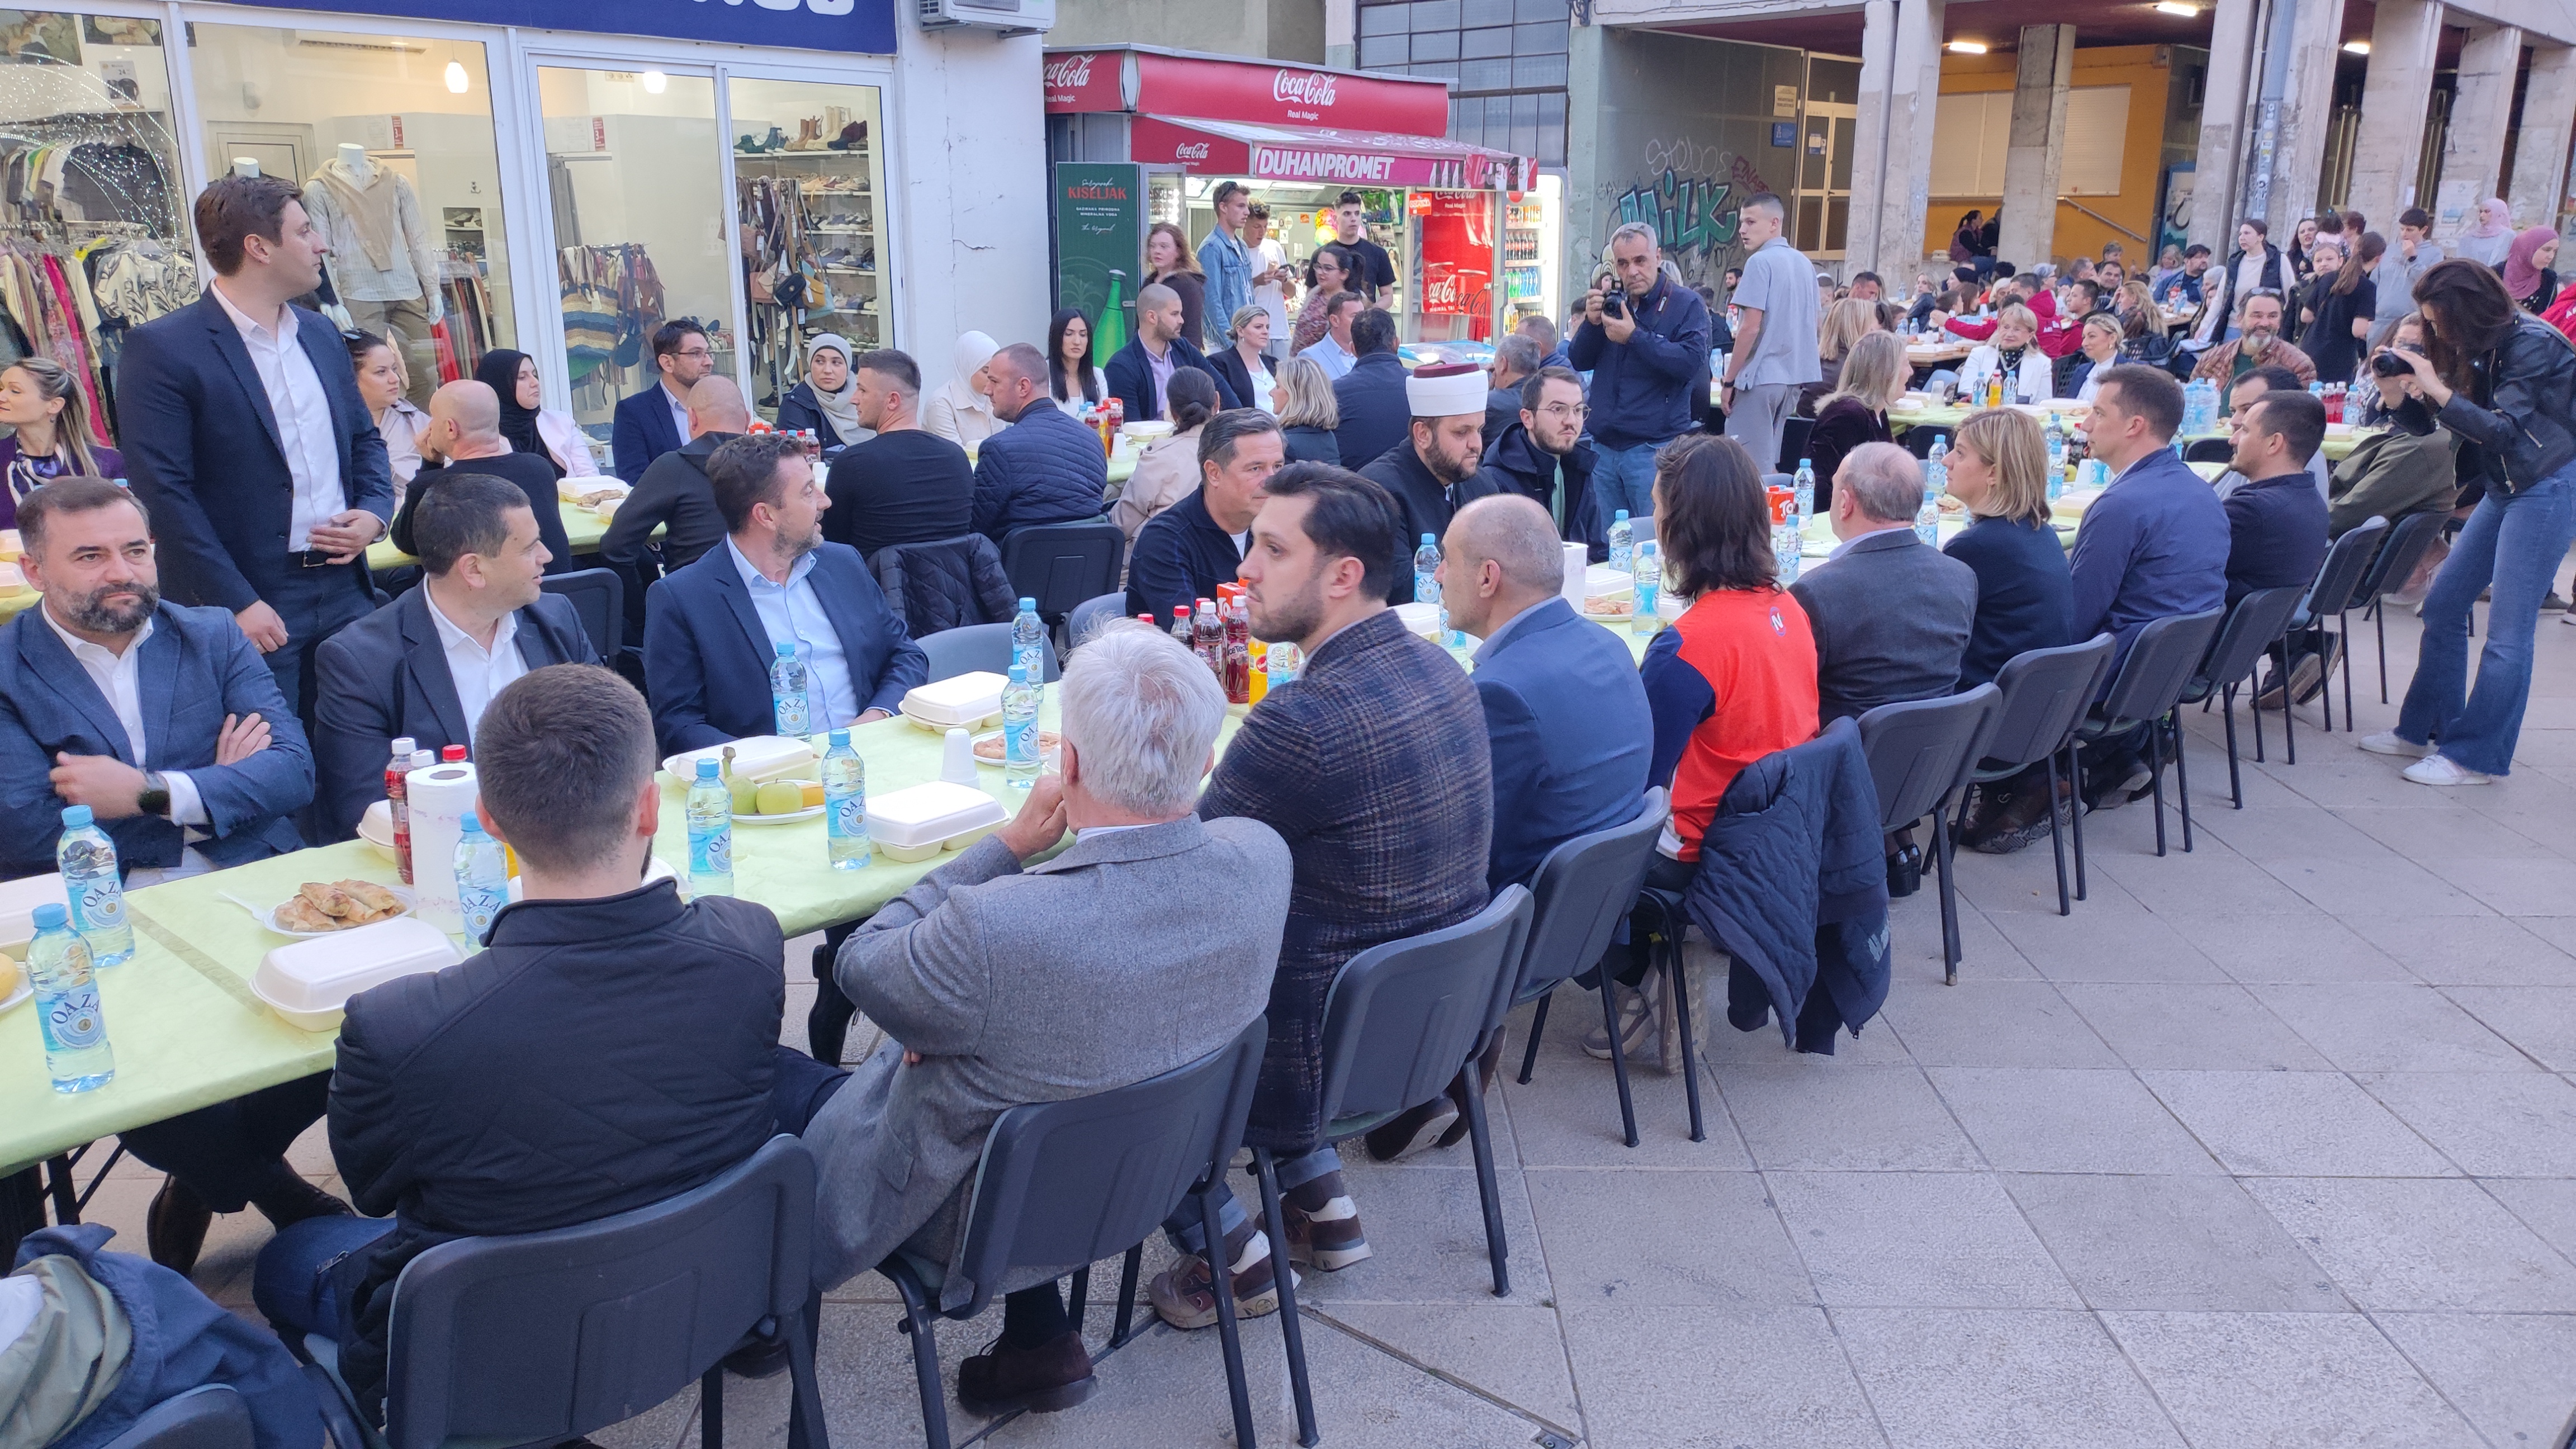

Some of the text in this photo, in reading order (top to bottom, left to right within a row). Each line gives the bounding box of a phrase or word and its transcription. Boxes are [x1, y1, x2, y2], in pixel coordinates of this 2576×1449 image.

[1043, 54, 1097, 88] ca-Cola
[1273, 69, 1337, 106] Coca-Cola
[1058, 94, 1076, 103] Magic
[1287, 110, 1319, 121] Real Magic
[1176, 142, 1210, 159] Coca-Cola
[1258, 149, 1395, 180] DUHANPROMET
[1068, 186, 1127, 200] KISELJAK
[778, 698, 806, 714] OAZA
[840, 796, 865, 817] OAZ
[83, 881, 122, 907] OAZA
[461, 894, 502, 915] OAZA
[51, 994, 100, 1024] OAZA
